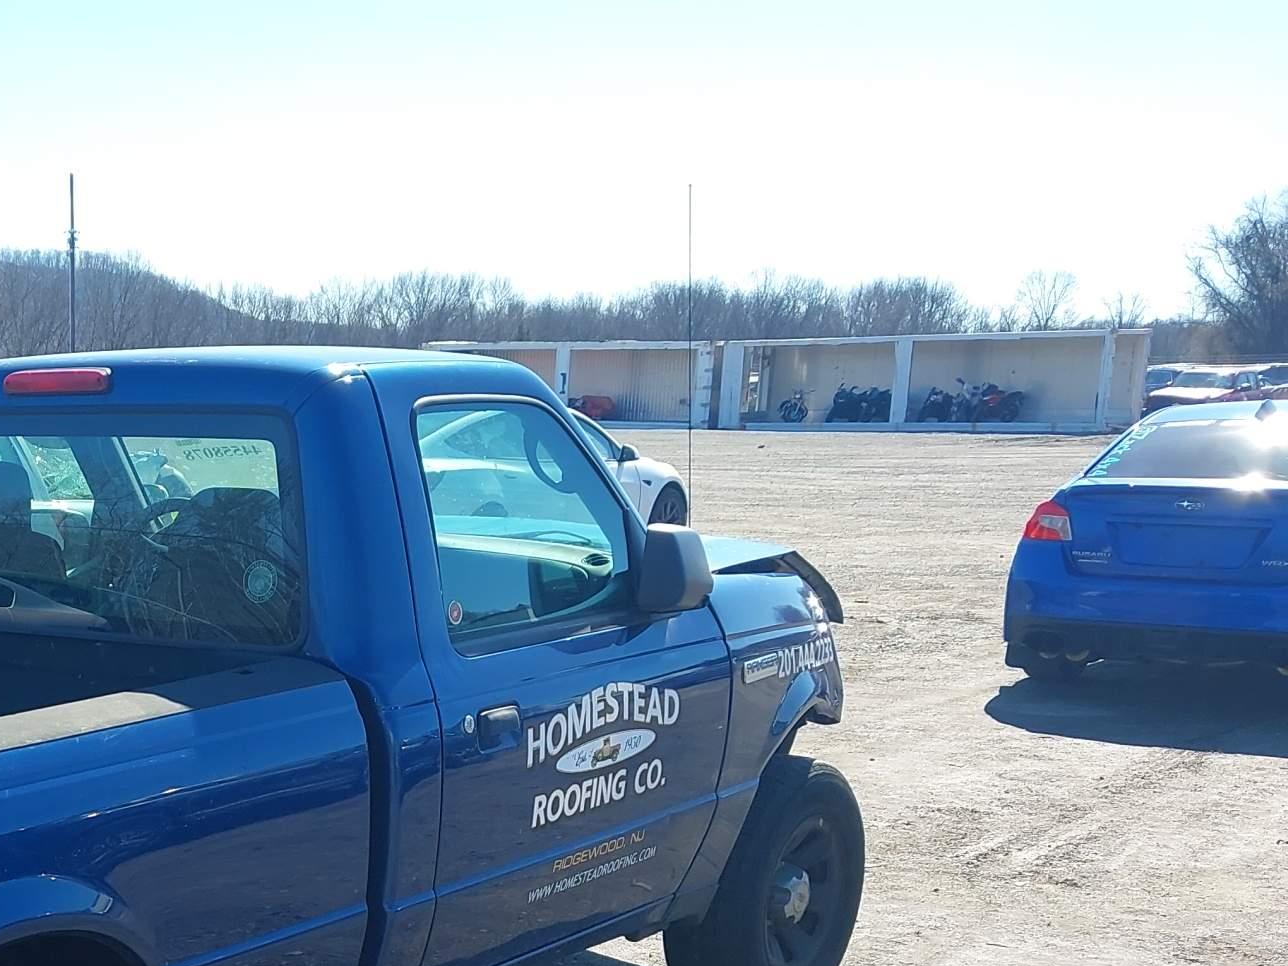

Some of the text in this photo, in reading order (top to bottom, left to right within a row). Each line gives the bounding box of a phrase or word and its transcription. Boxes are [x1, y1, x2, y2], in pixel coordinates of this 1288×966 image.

[778, 636, 834, 679] 201.444.2233
[526, 681, 680, 769] HOMESTEAD
[530, 758, 666, 829] ROOFING CO.
[553, 829, 646, 873] RIDGEWOOD, NJ
